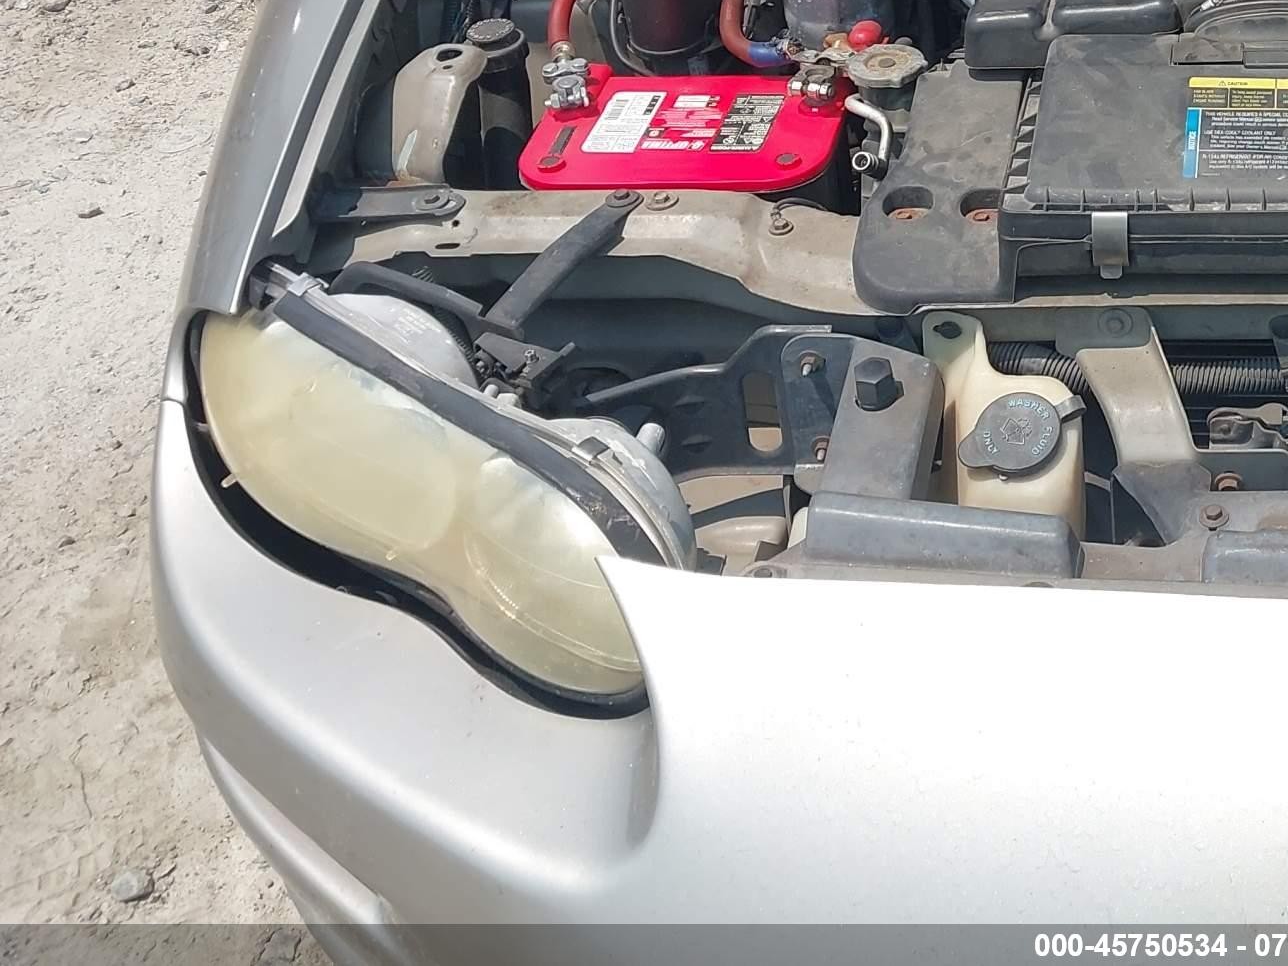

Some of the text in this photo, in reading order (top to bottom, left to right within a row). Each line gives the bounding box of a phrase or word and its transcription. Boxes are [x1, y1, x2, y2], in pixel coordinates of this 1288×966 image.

[983, 399, 1053, 455] WASHER FLUID ONLY
